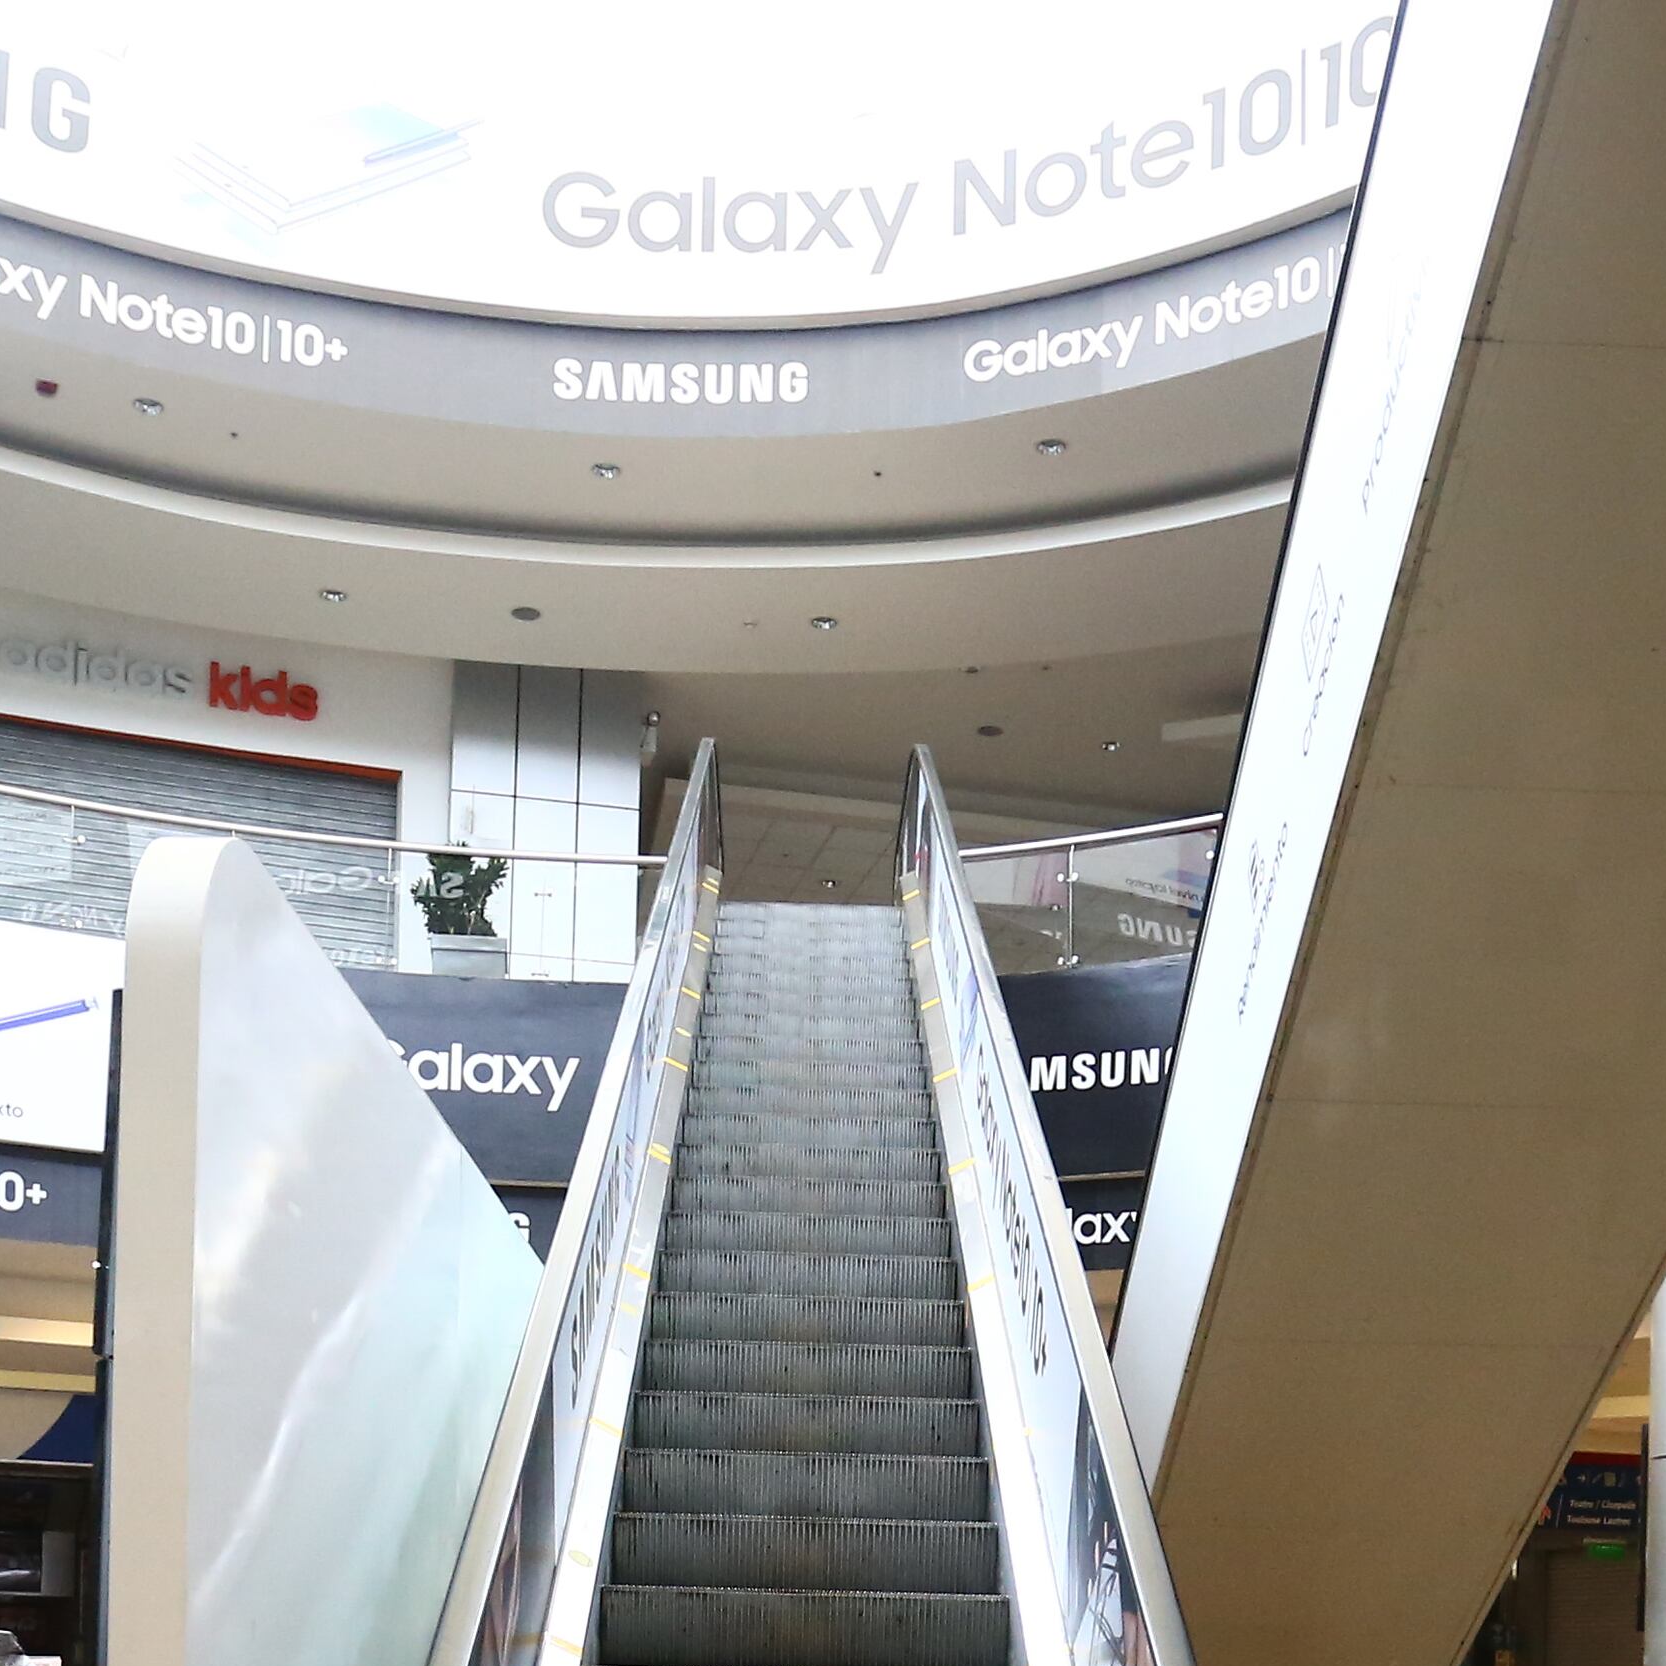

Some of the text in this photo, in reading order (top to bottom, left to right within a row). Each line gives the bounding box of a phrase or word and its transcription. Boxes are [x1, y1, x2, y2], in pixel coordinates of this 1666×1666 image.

[541, 171, 919, 275] Galaxy
[962, 312, 1145, 384] Galaxy
[552, 357, 809, 404] SAMSUNG
[208, 660, 319, 722] kids
[1030, 1046, 1172, 1091] MSUN
